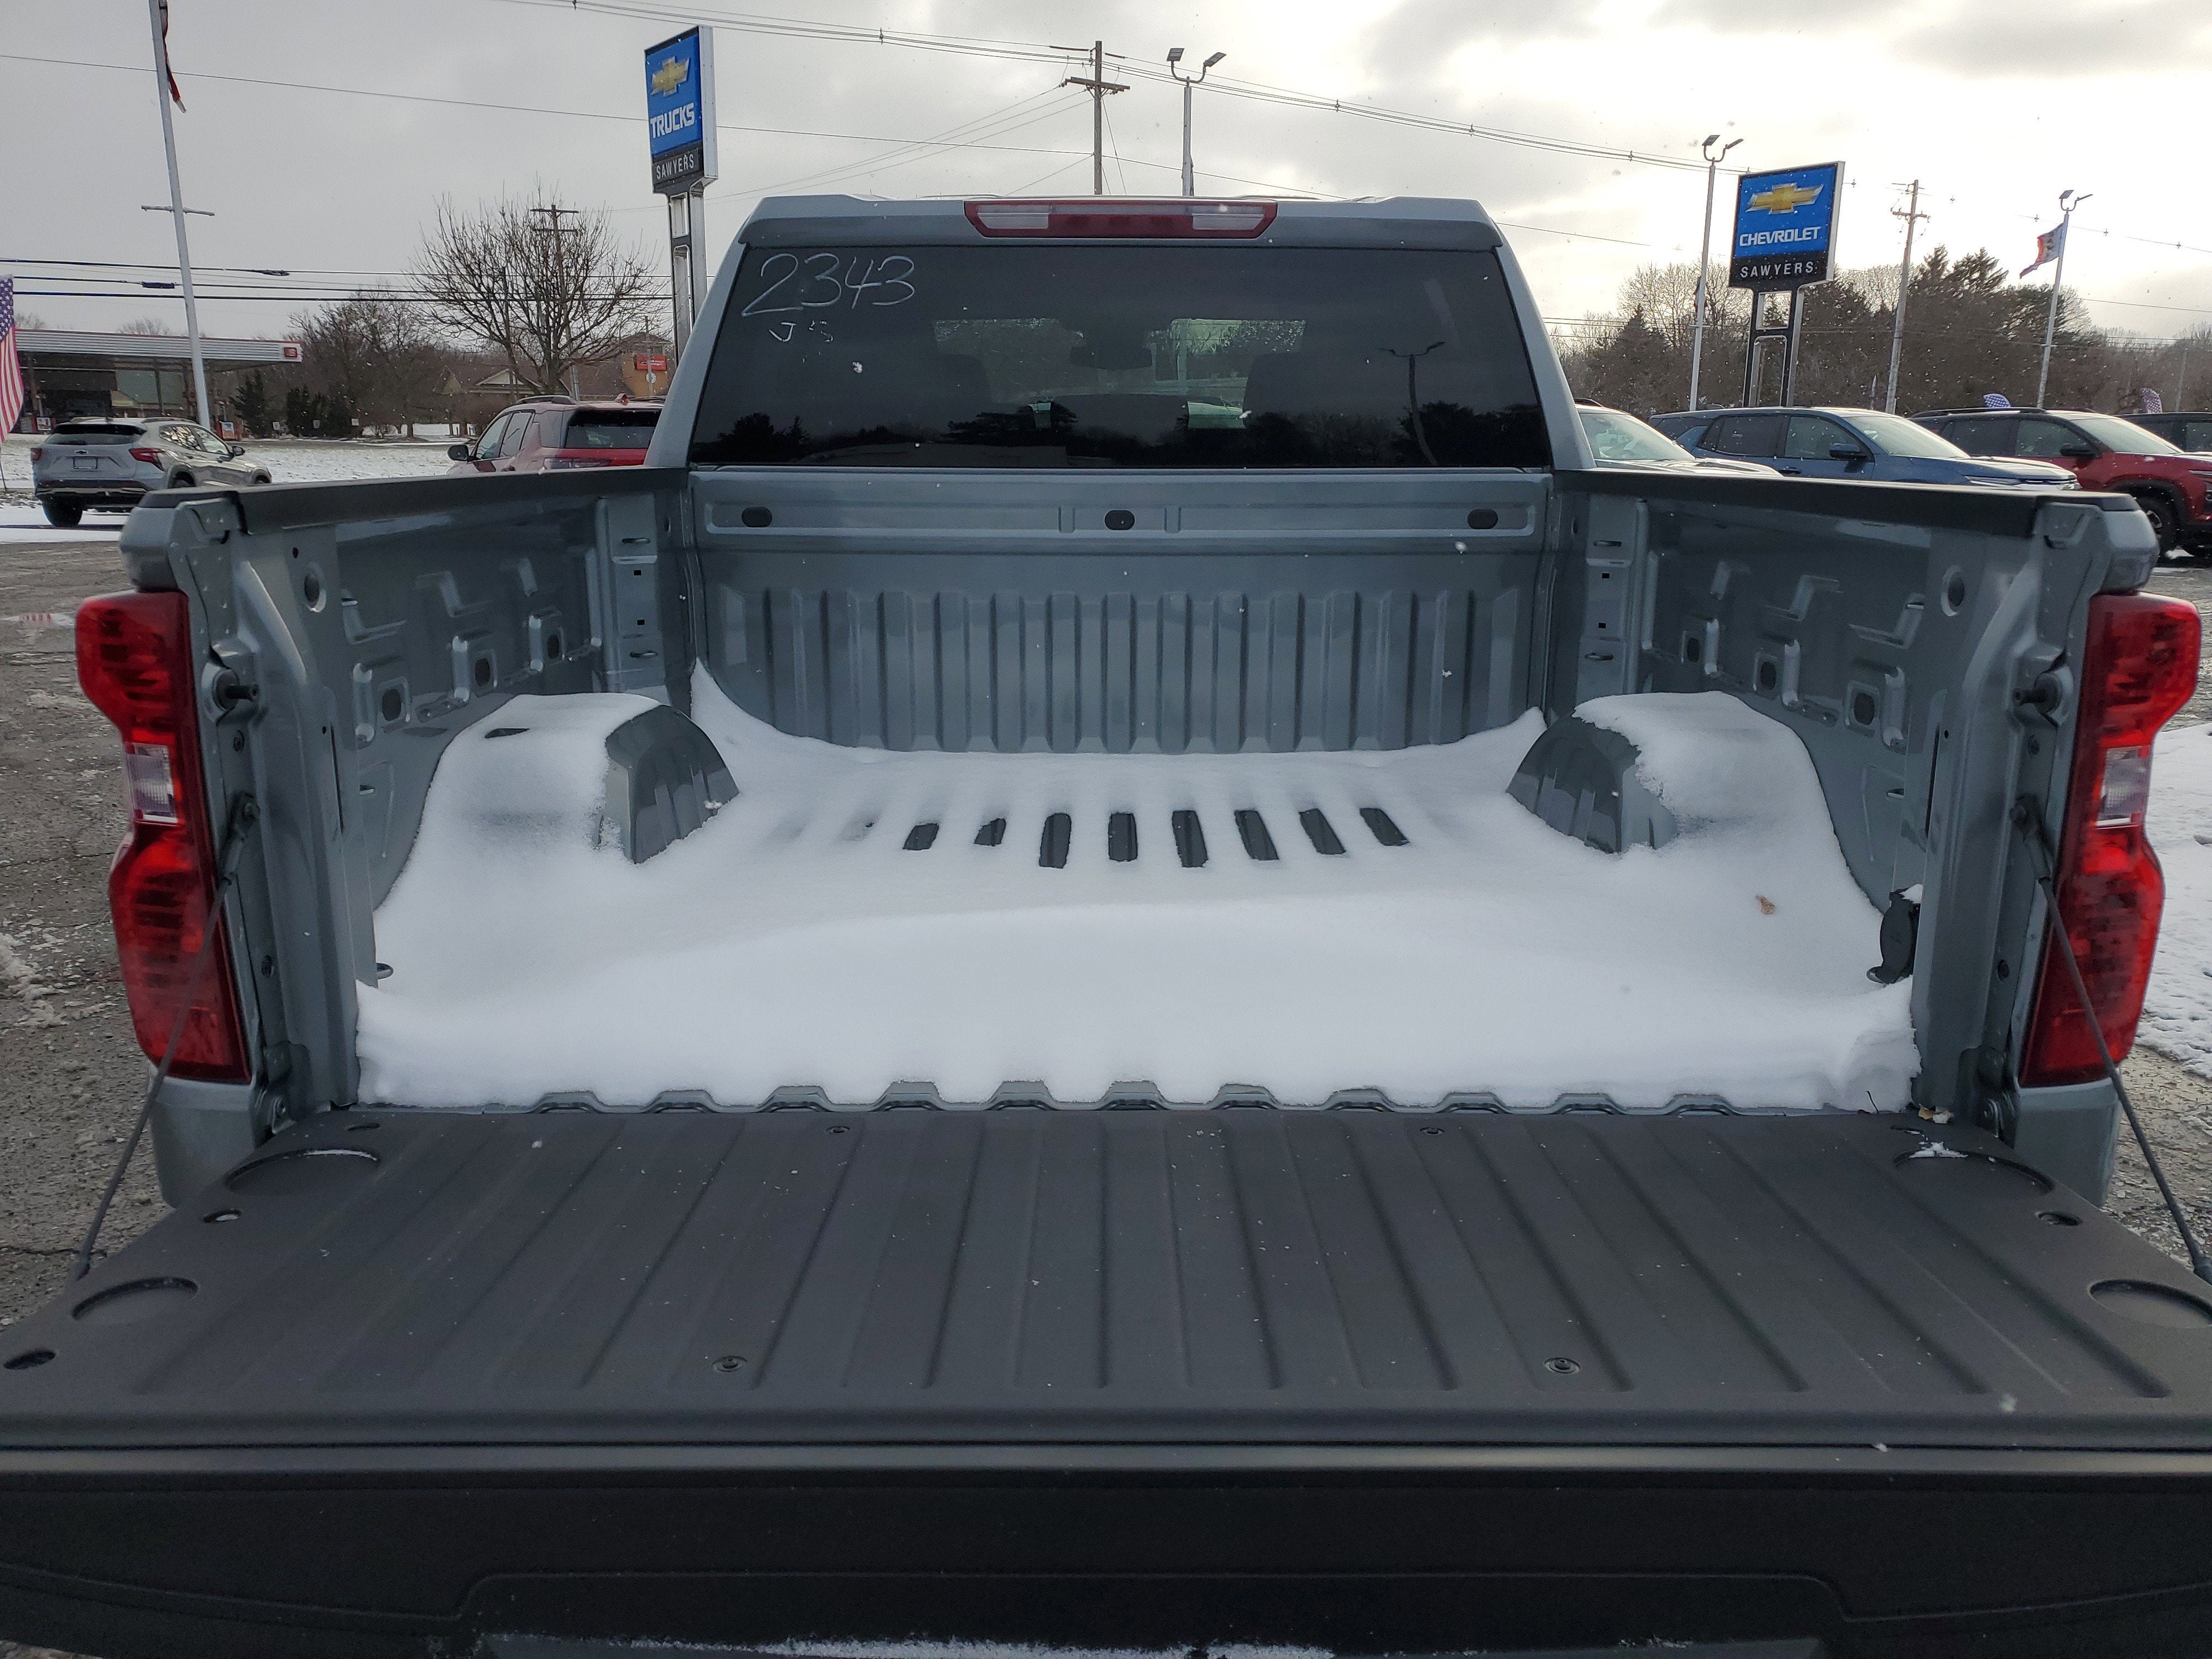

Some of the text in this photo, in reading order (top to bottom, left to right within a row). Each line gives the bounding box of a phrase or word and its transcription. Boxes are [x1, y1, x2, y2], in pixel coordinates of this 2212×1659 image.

[650, 103, 695, 139] TRUCKS
[656, 154, 694, 179] SAWYERS
[1740, 226, 1821, 246] CHEVROLET
[1740, 261, 1814, 278] SAWYERS
[741, 253, 915, 317] 2343
